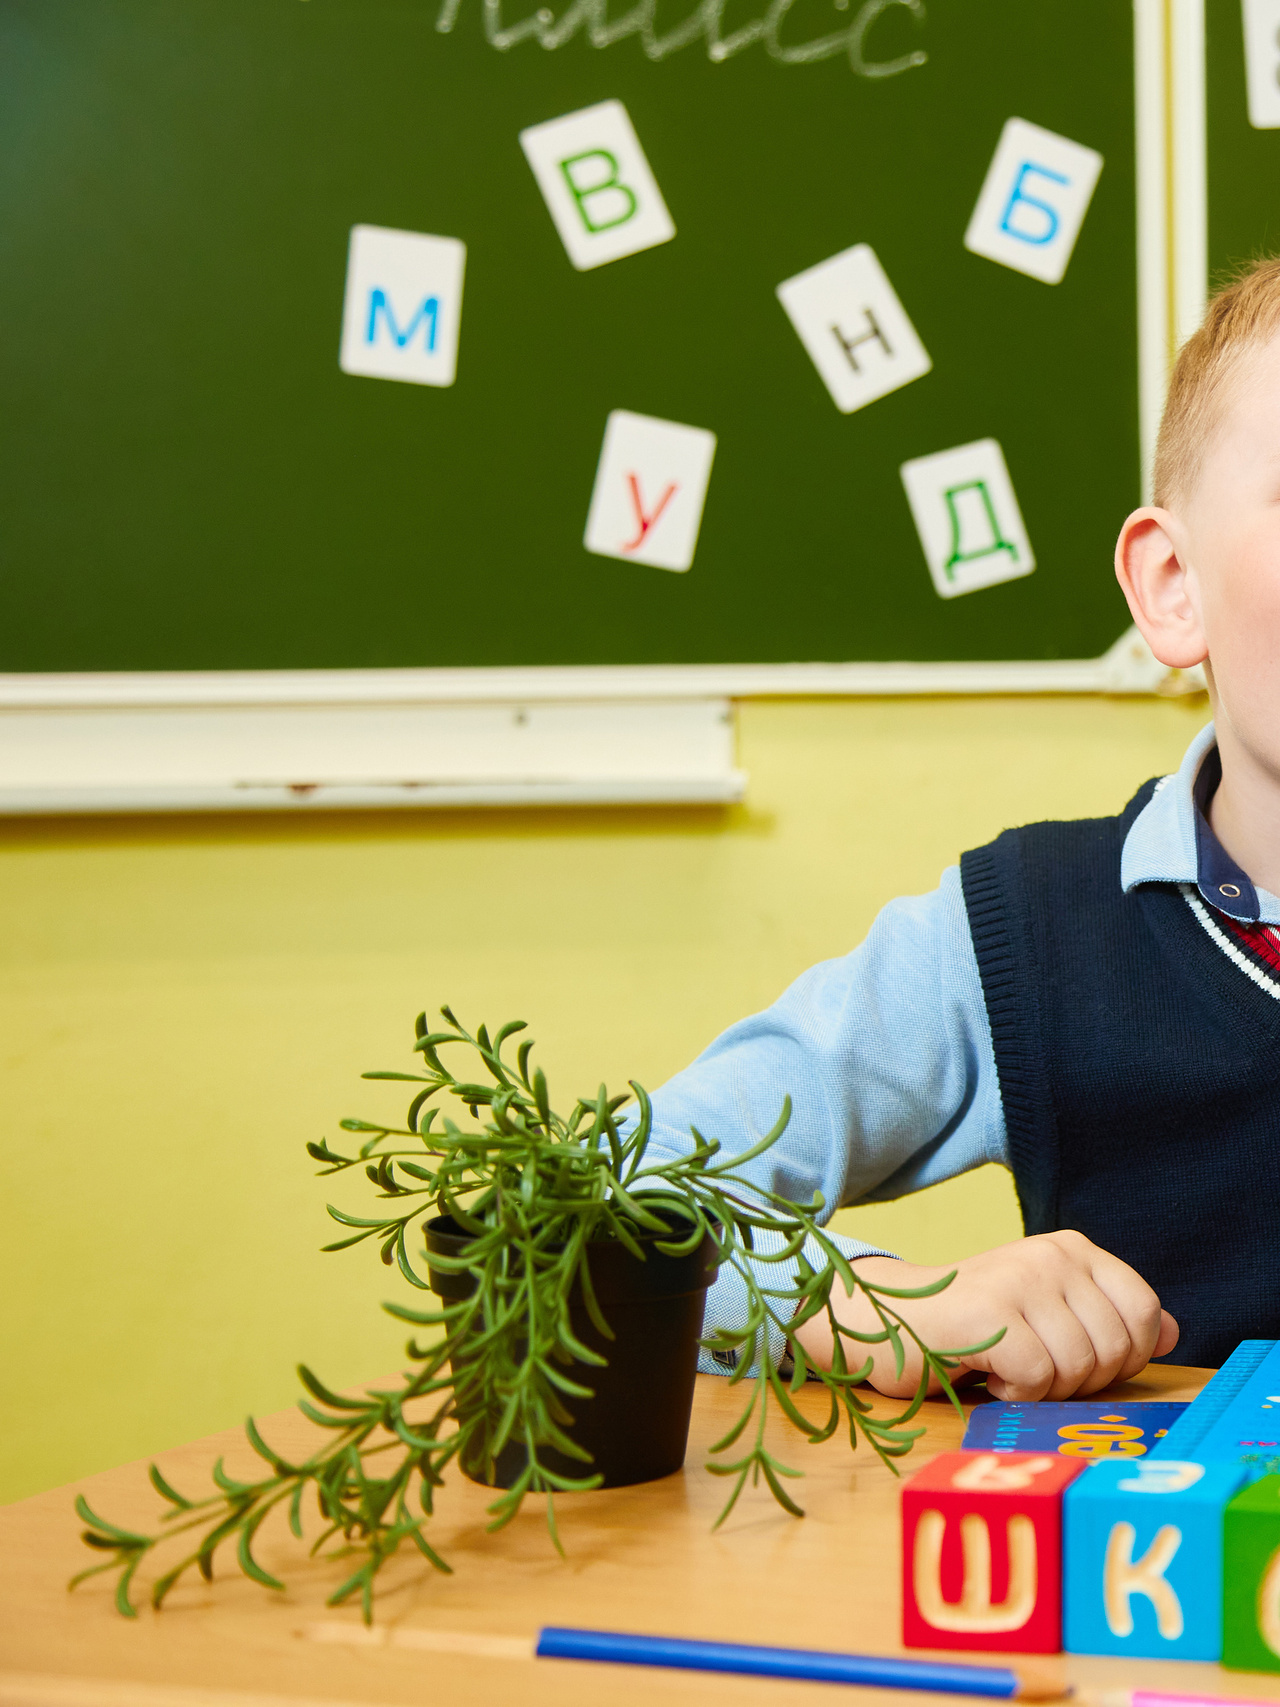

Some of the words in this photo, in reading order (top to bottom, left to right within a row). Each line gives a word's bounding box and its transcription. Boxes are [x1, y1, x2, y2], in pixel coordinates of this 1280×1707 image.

[557, 148, 639, 235] В
[997, 159, 1072, 247] Б
[942, 478, 1021, 583] Д
